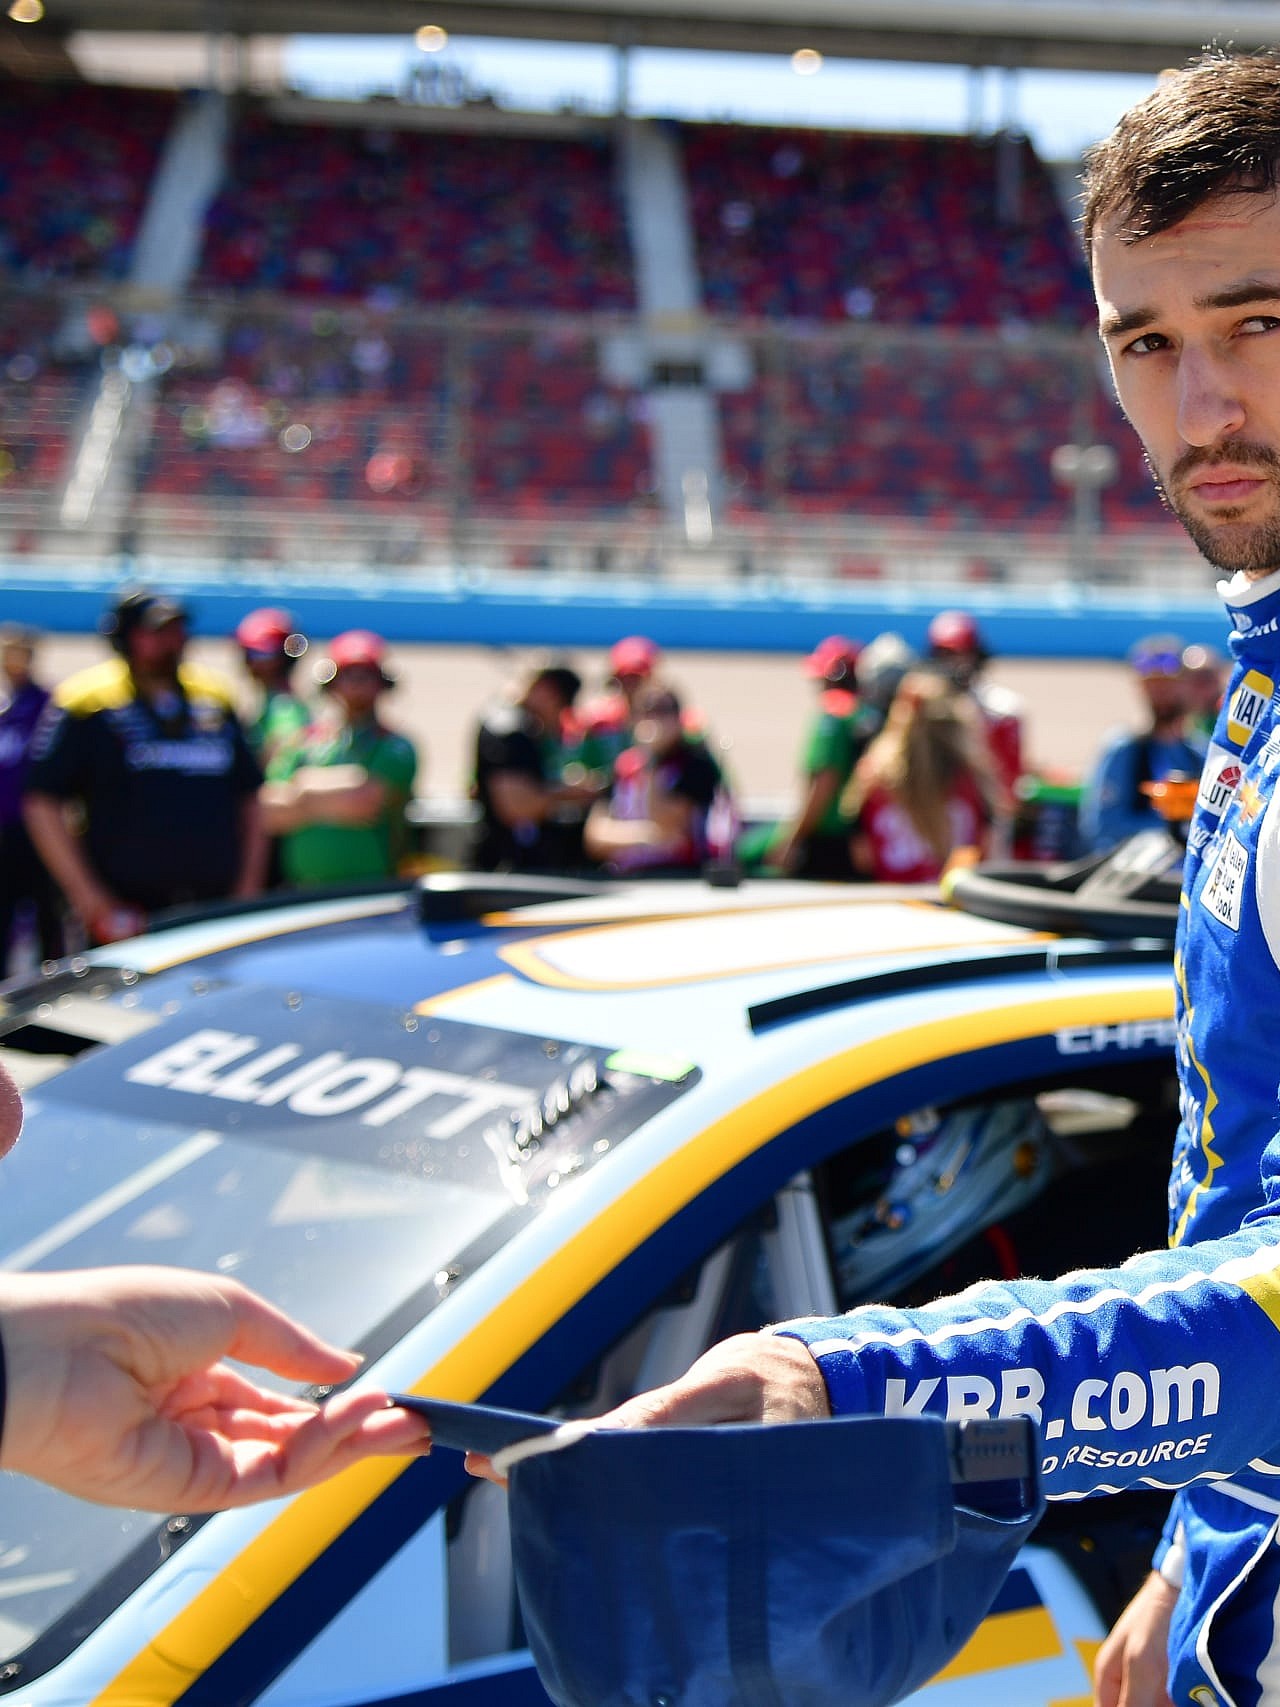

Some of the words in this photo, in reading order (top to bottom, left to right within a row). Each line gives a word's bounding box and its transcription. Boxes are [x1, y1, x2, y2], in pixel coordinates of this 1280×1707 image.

[1055, 1016, 1176, 1055] CHA
[125, 1028, 540, 1140] ELLIOTT
[1062, 1433, 1213, 1470] RESOURCE
